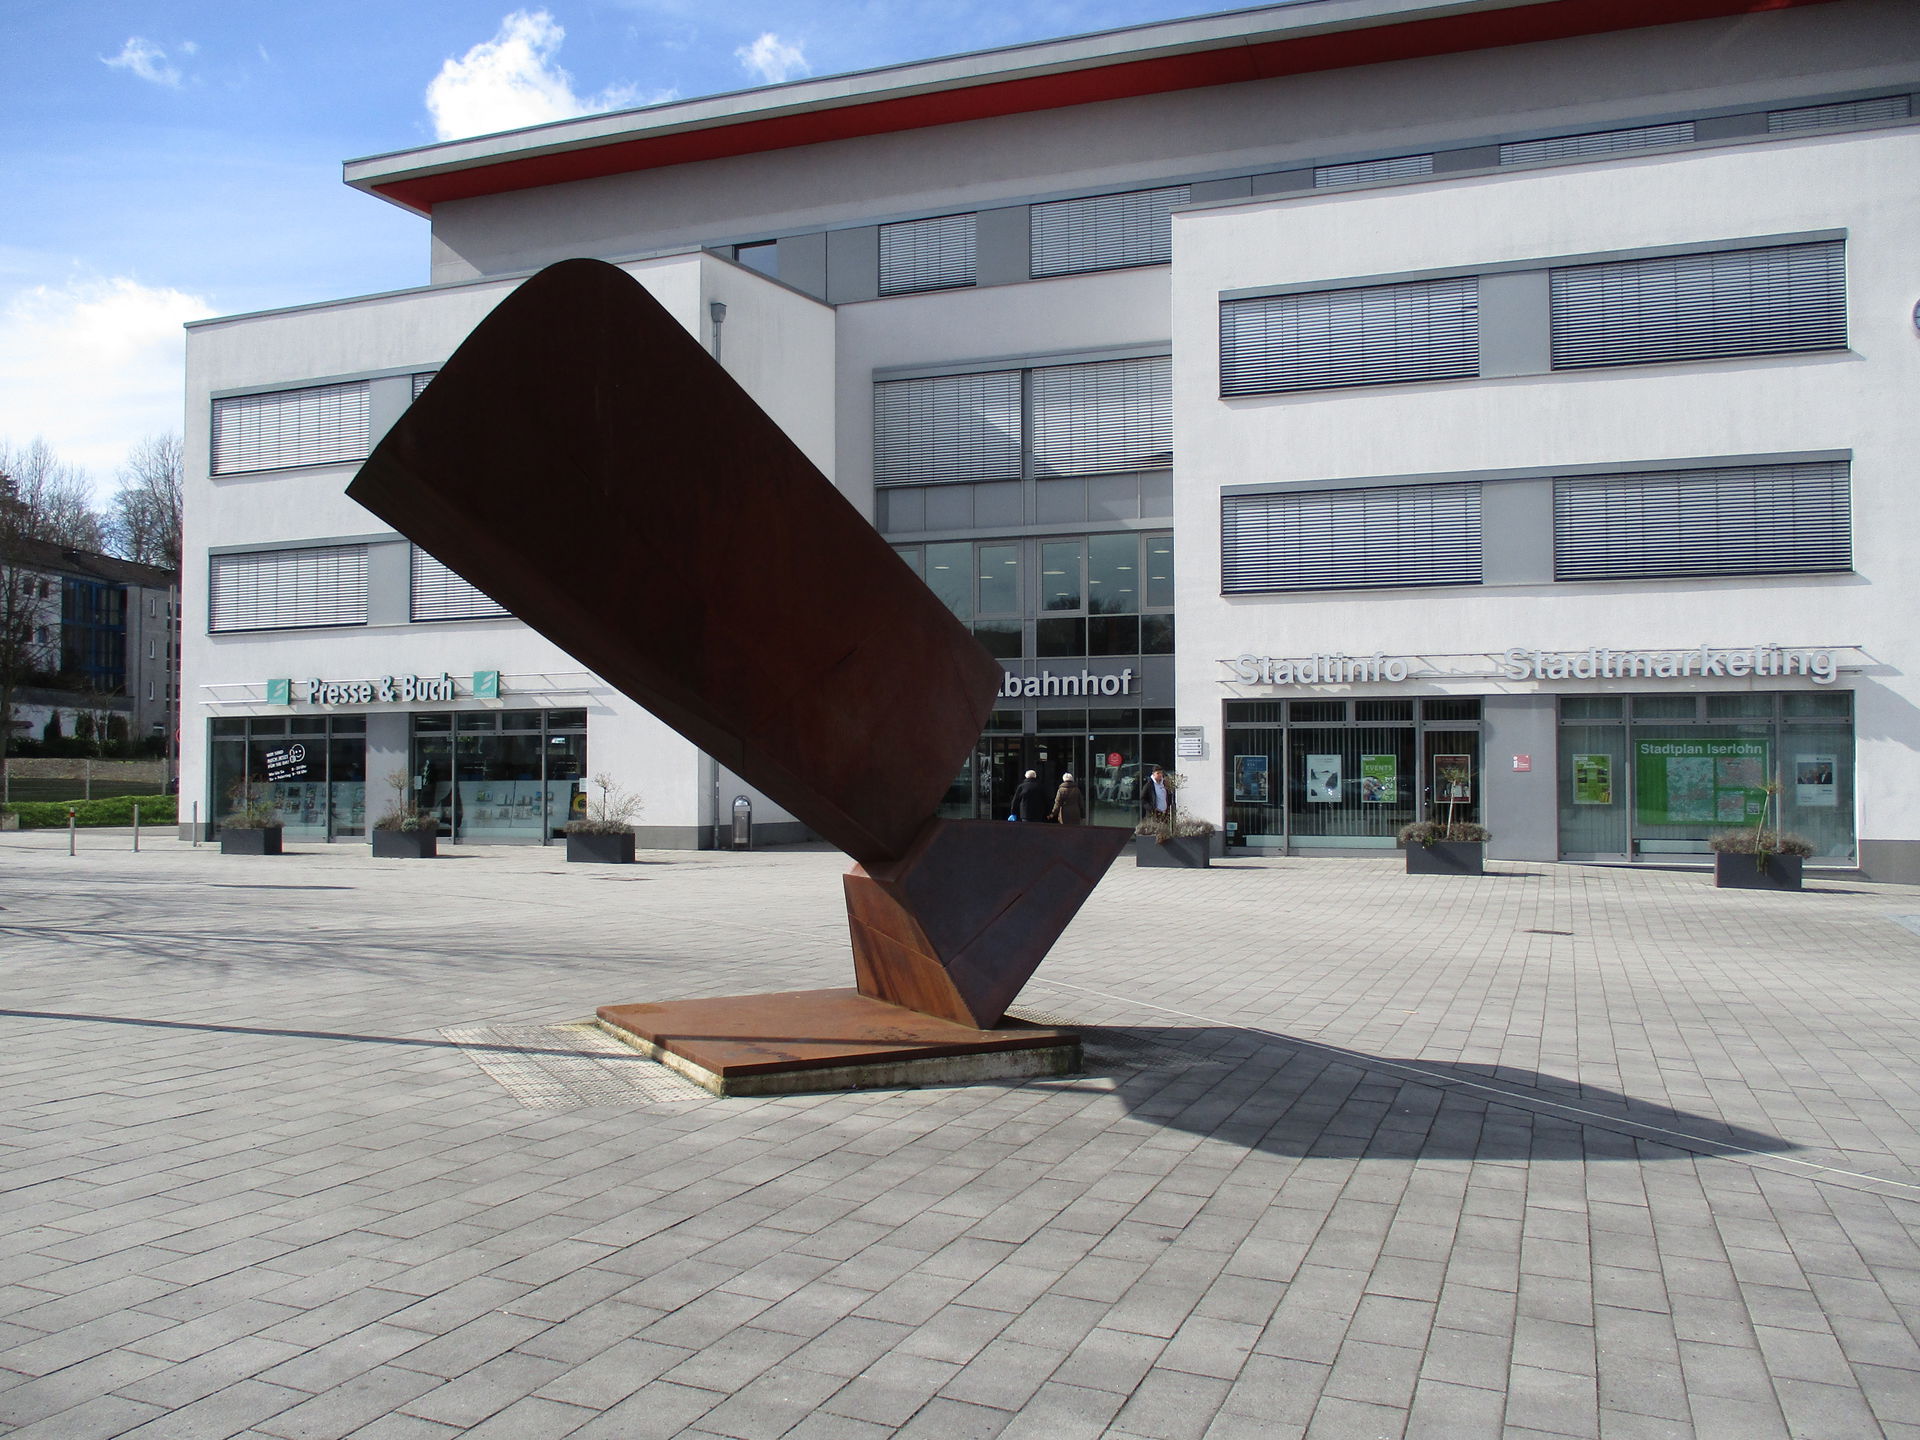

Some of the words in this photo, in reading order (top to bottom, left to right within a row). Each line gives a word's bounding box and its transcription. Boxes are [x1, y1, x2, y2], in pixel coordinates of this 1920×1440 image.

[1235, 651, 1408, 685] Stadtinfo
[1503, 643, 1837, 684] Stadtmarketing
[307, 678, 372, 704] Presse
[378, 675, 396, 702] &
[402, 672, 455, 702] Buch
[1640, 743, 1702, 756] Stadtplan
[1707, 743, 1762, 754] Iserlohn
